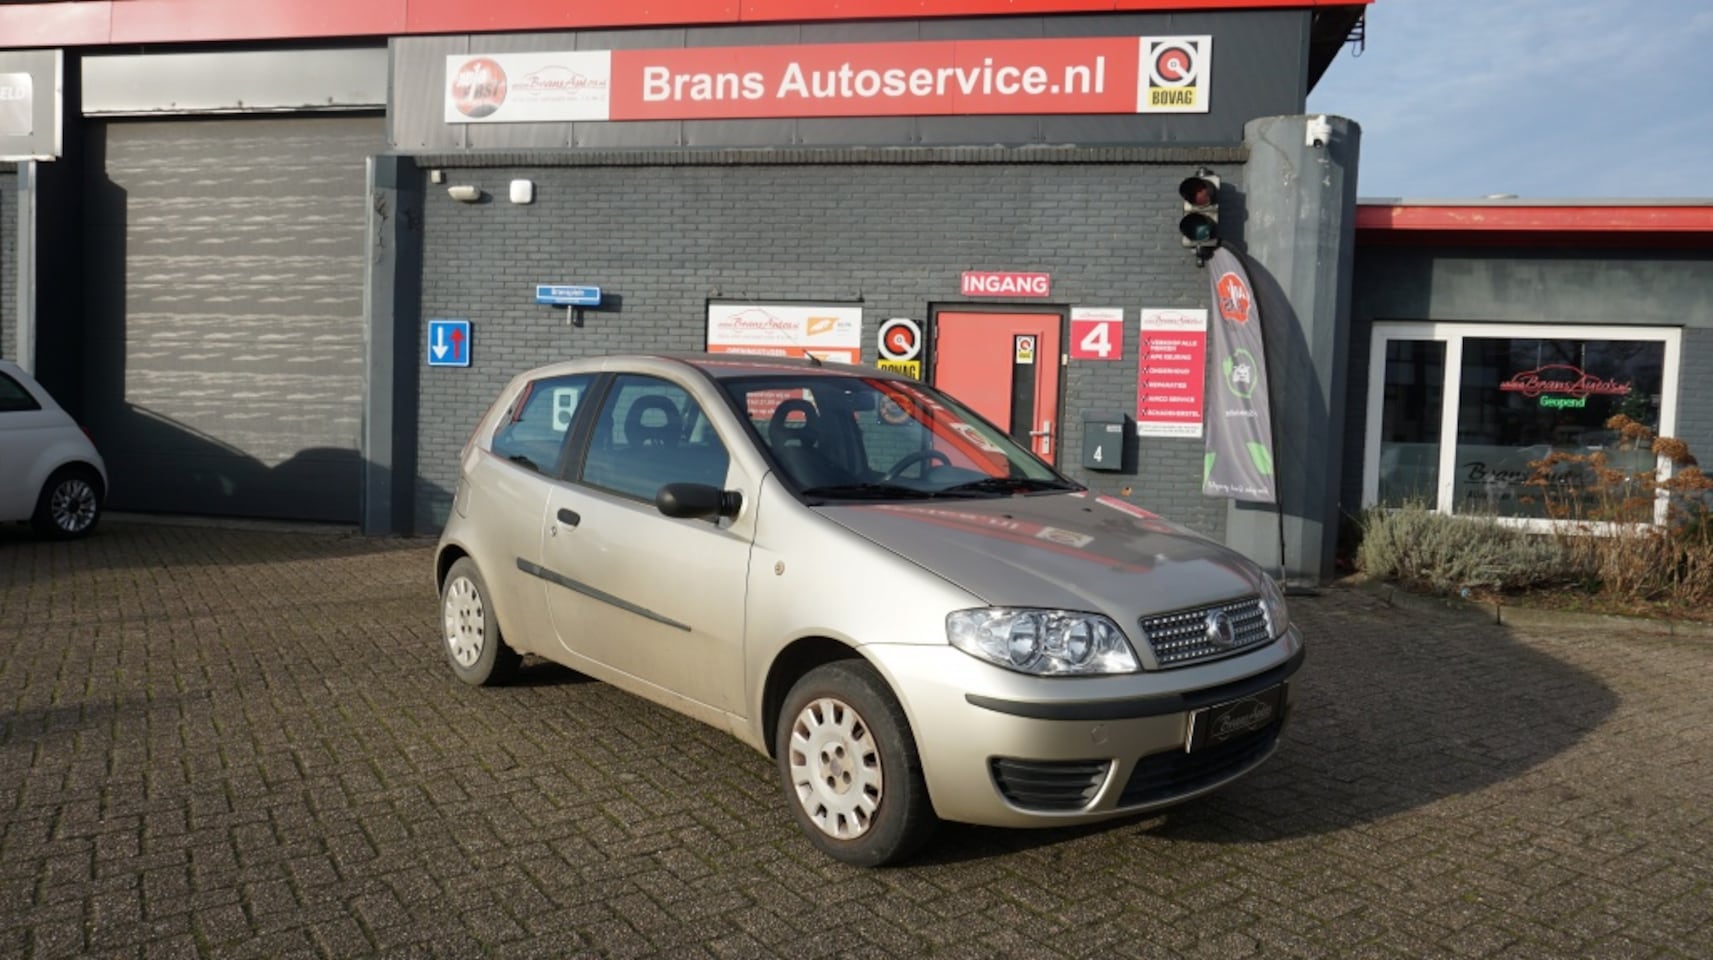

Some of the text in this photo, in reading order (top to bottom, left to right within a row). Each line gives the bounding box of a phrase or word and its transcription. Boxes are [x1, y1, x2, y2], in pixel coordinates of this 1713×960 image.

[643, 56, 1105, 101] Brans Autoservice.nl
[1151, 90, 1193, 105] BOVAG
[963, 275, 1048, 293] INGANG
[1080, 322, 1112, 357] 4
[1540, 395, 1586, 409] Geopend
[1093, 445, 1103, 463] 4
